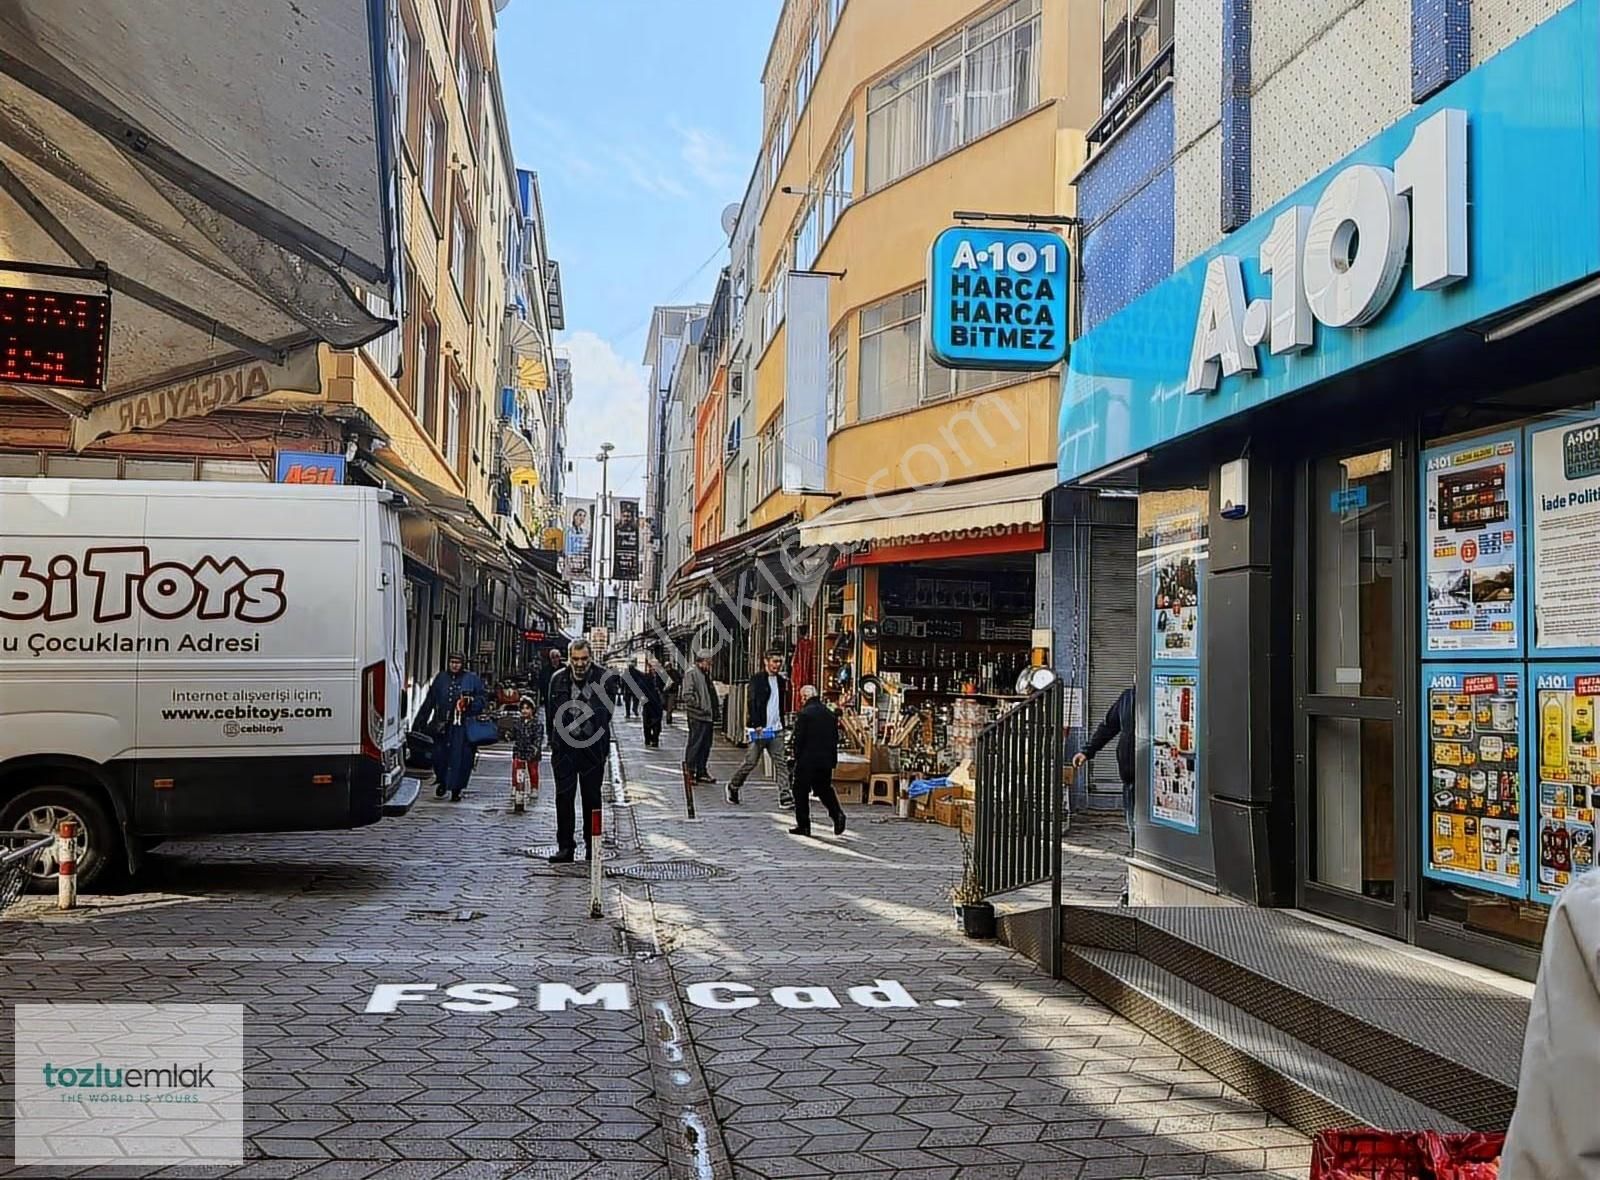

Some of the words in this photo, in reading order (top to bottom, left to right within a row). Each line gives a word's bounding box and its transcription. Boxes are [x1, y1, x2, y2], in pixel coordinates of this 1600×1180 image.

[951, 275, 1056, 300] HARCA
[951, 301, 1056, 326] HARCA
[27, 632, 170, 657] Çocukların
[177, 632, 260, 653] Adresi
[161, 705, 333, 721] www.cebitoys.com
[240, 723, 284, 735] cebitoys
